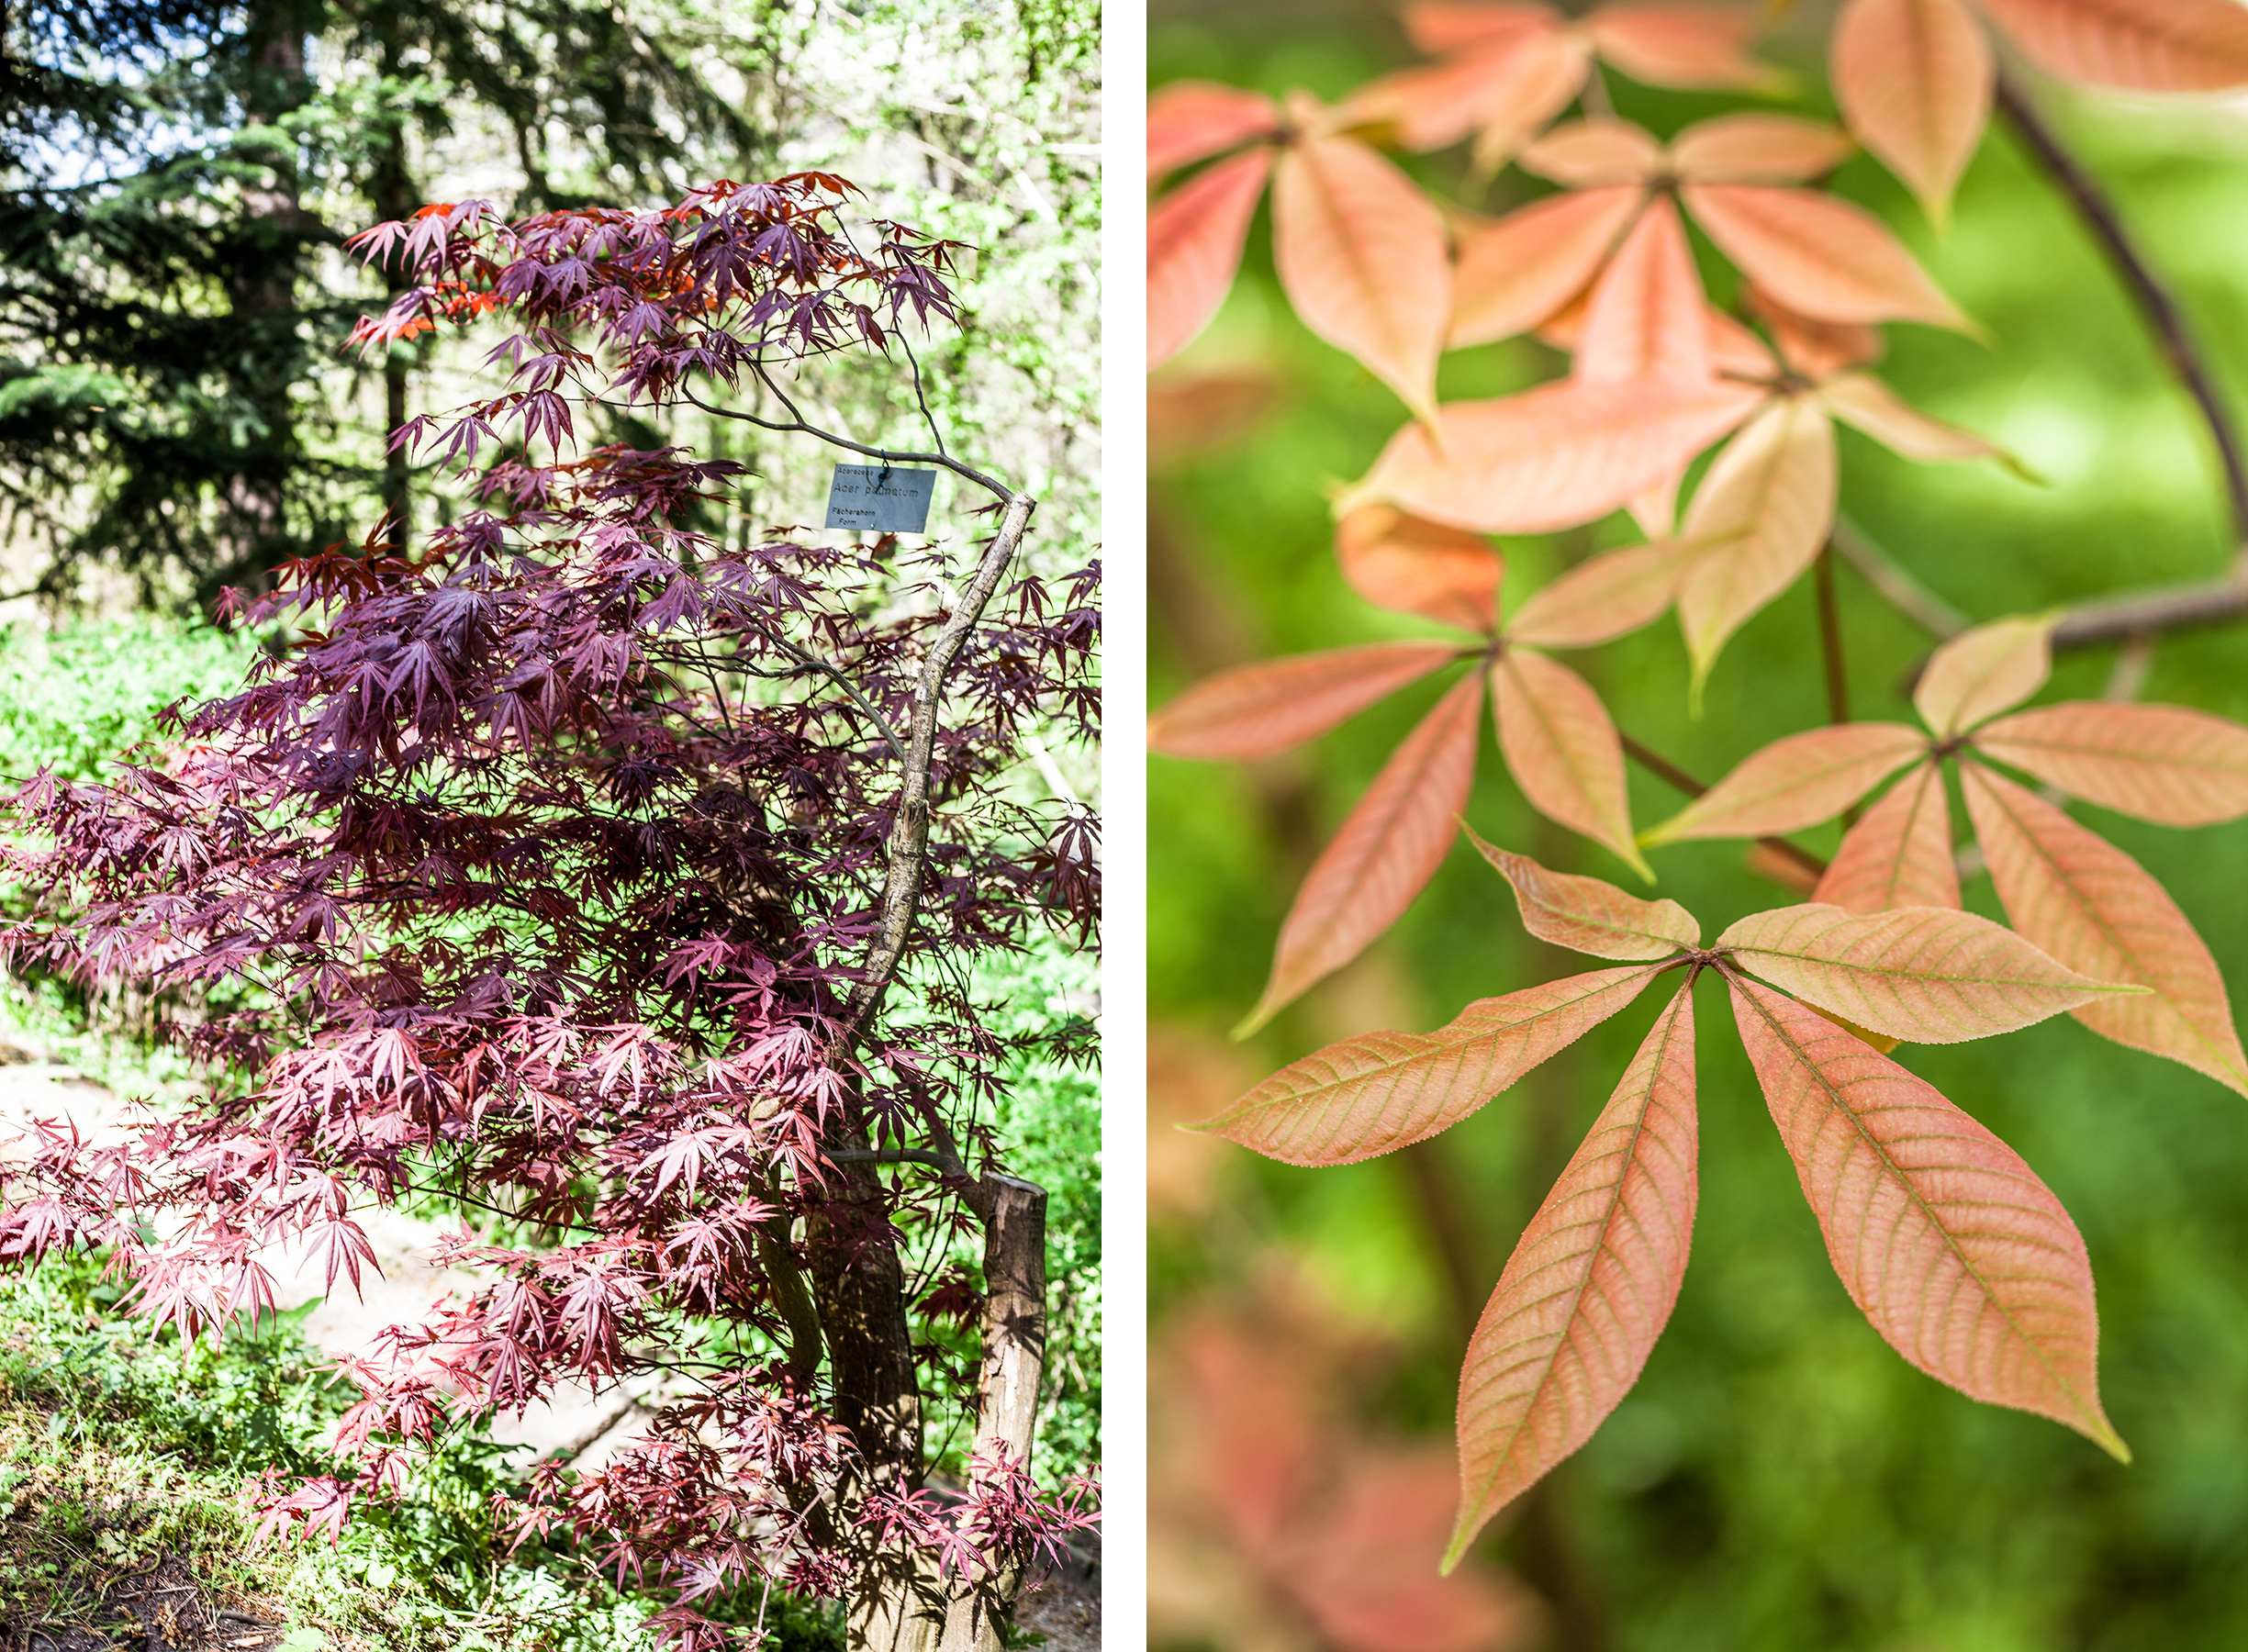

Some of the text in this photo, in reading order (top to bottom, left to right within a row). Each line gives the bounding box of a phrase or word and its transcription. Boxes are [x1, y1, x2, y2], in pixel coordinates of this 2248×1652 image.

[833, 482, 859, 495] Acer
[832, 507, 876, 517] Fächerahorn
[838, 518, 857, 527] Form
